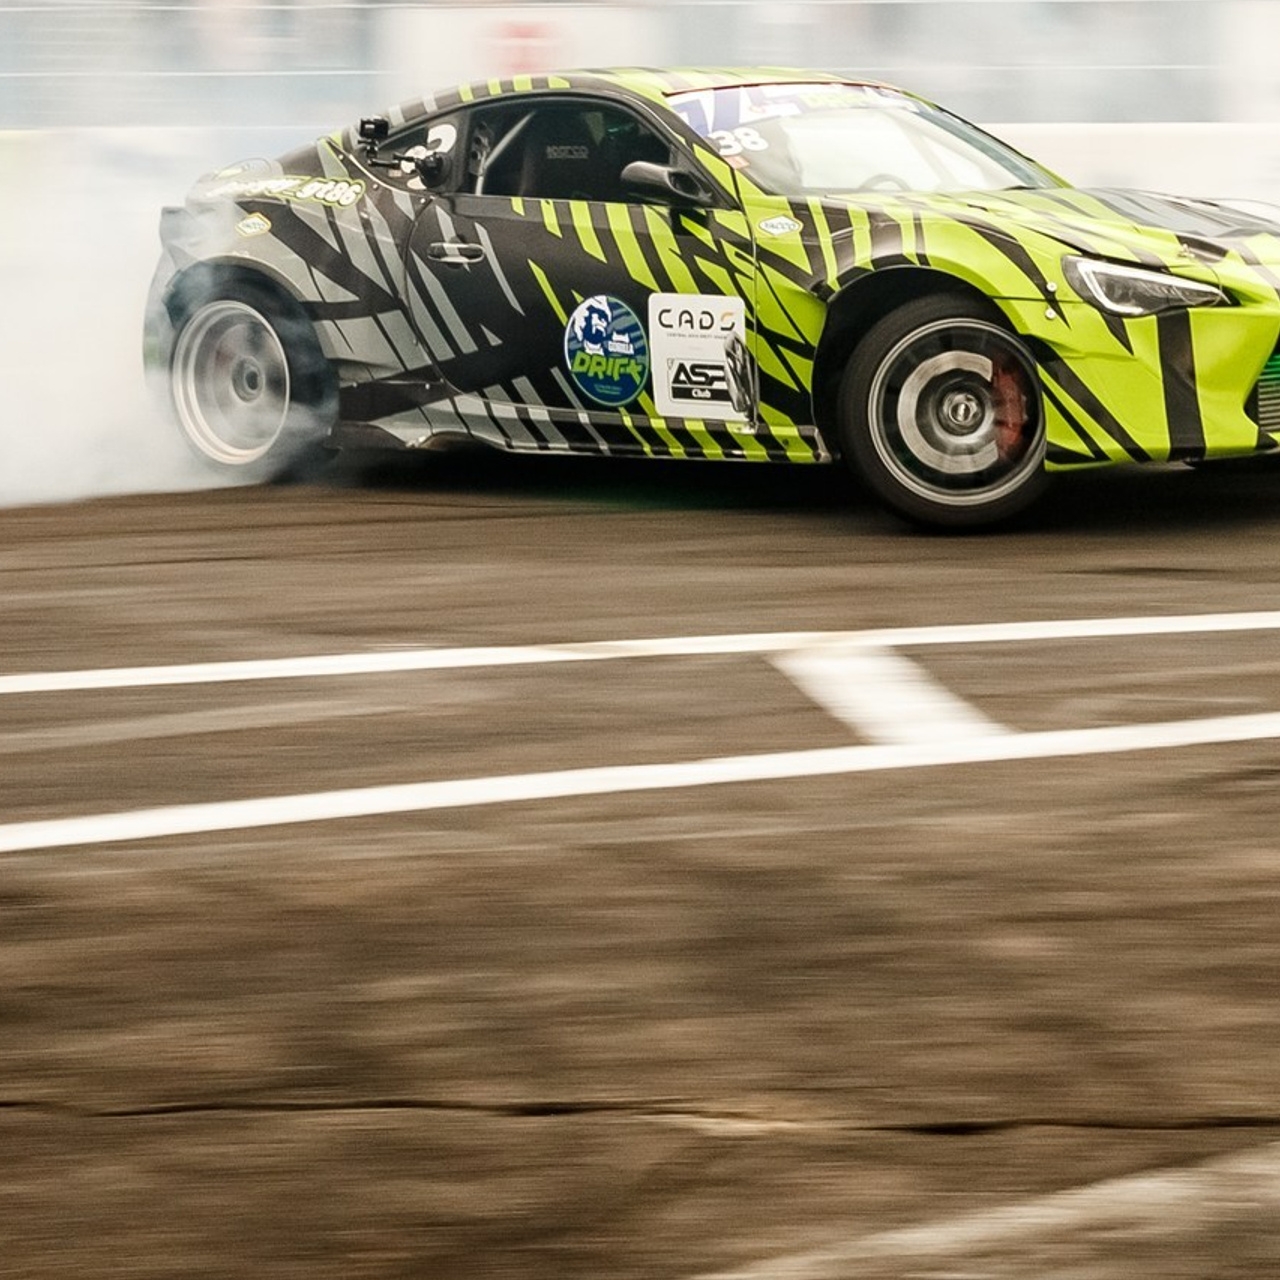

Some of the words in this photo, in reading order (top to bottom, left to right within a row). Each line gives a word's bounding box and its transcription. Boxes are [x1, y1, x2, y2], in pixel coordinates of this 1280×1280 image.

[710, 127, 769, 156] 38
[658, 309, 735, 331] CADS
[571, 350, 643, 385] DRIFT
